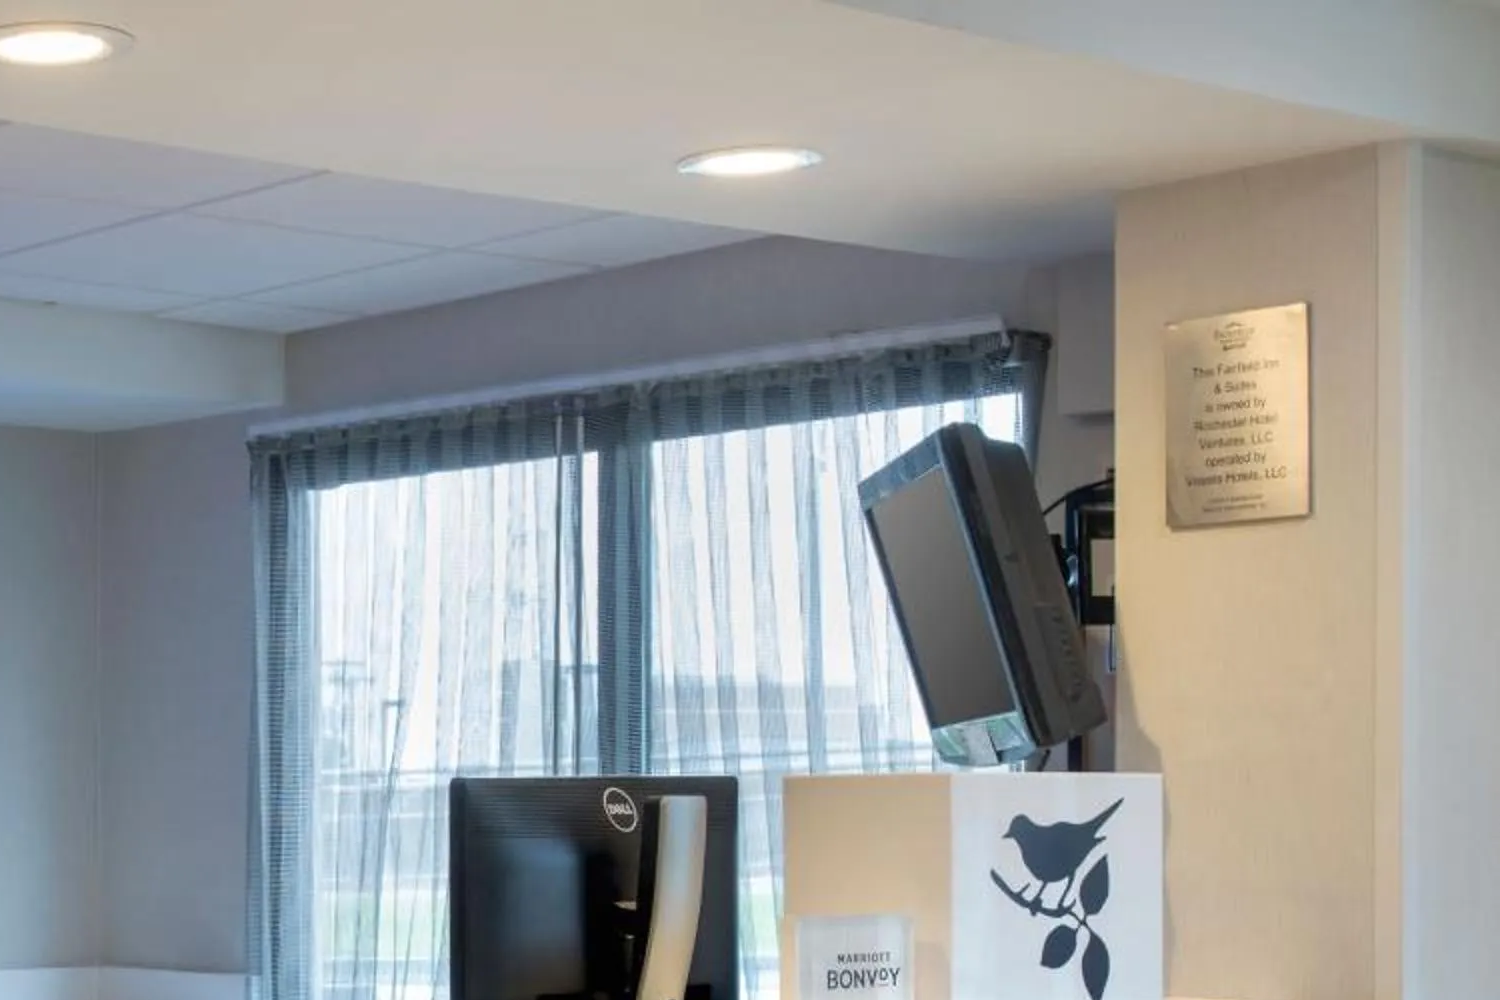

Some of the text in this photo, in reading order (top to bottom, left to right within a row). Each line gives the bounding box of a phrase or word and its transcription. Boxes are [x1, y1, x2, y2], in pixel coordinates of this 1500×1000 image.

[1216, 399, 1251, 412] owned
[1253, 397, 1267, 410] by
[1251, 431, 1274, 445] LLC
[1205, 451, 1267, 468] operated by
[1264, 465, 1287, 480] LLC
[605, 803, 633, 815] DELL
[837, 951, 891, 964] MARRIOTT
[827, 967, 901, 990] BONVOY
